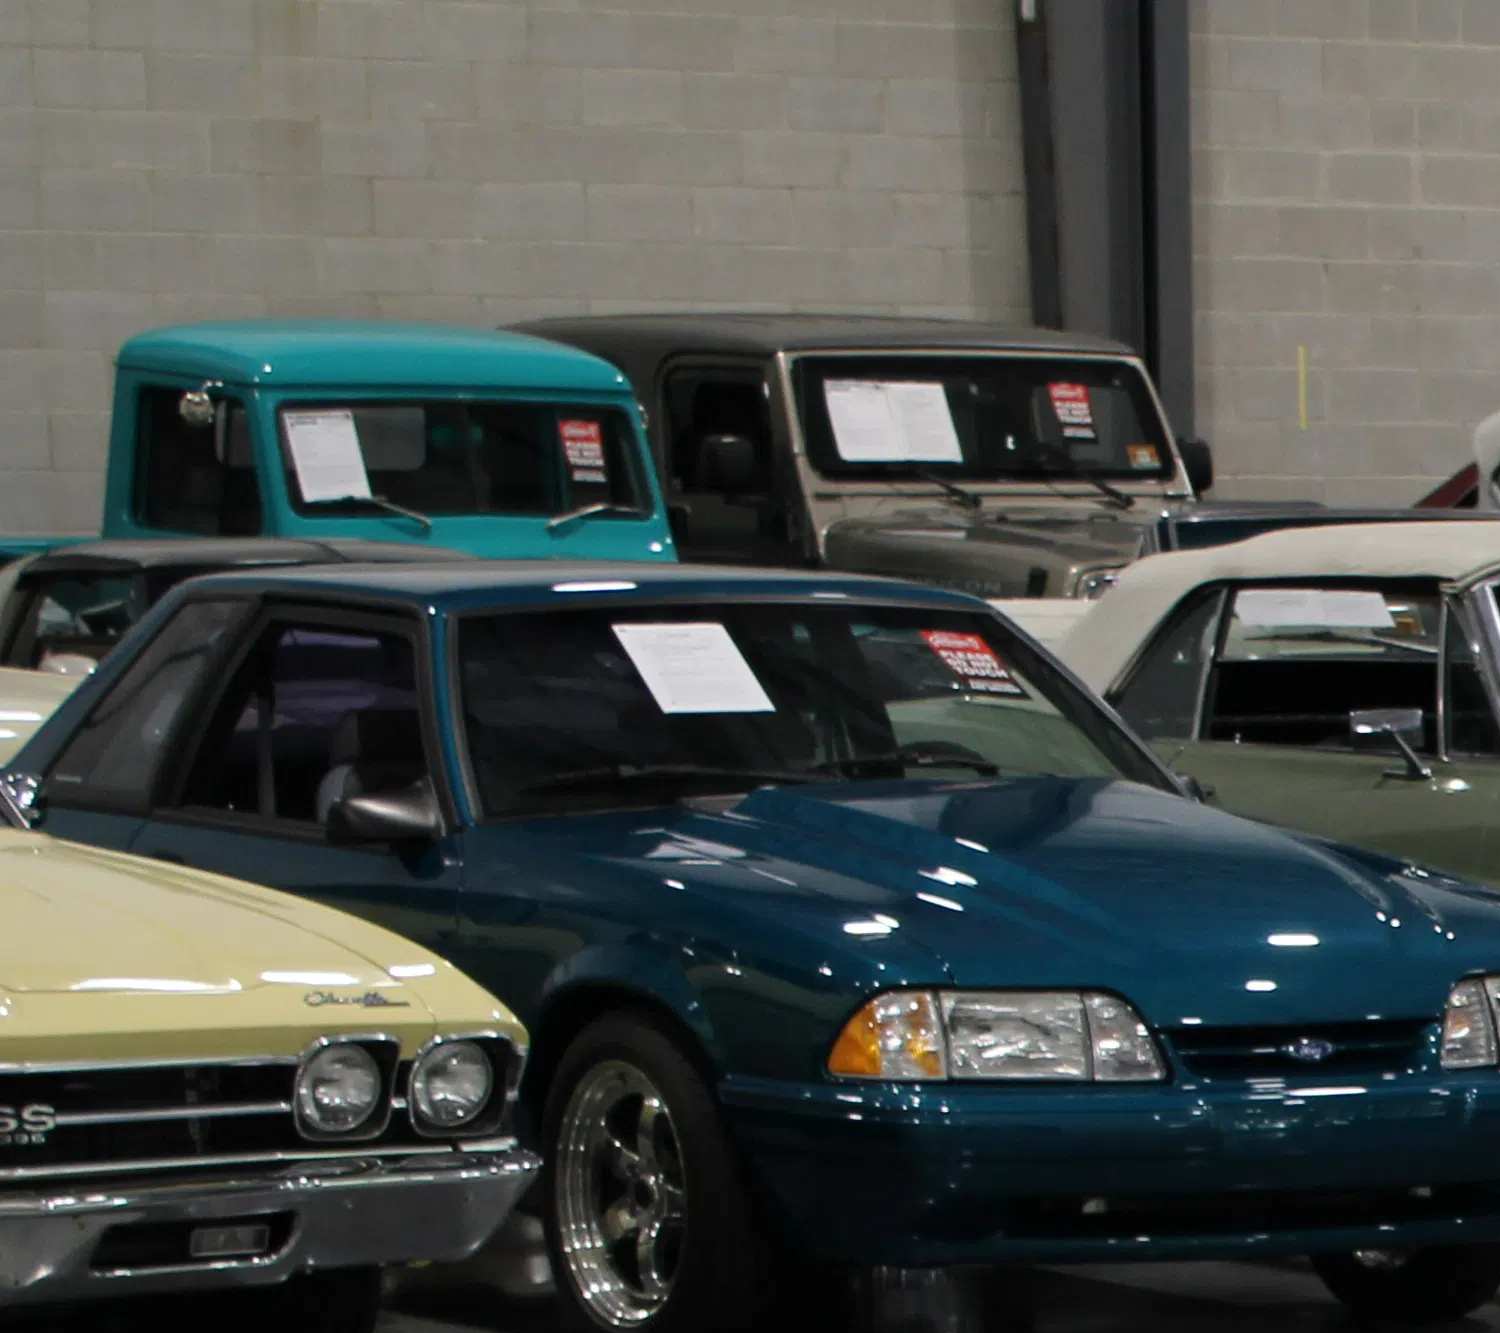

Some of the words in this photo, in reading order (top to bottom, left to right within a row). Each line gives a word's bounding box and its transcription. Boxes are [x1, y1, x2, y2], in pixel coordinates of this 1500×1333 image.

[939, 650, 996, 661] PLEASE
[954, 666, 1008, 678] TOUCH
[0, 1105, 57, 1132] SS
